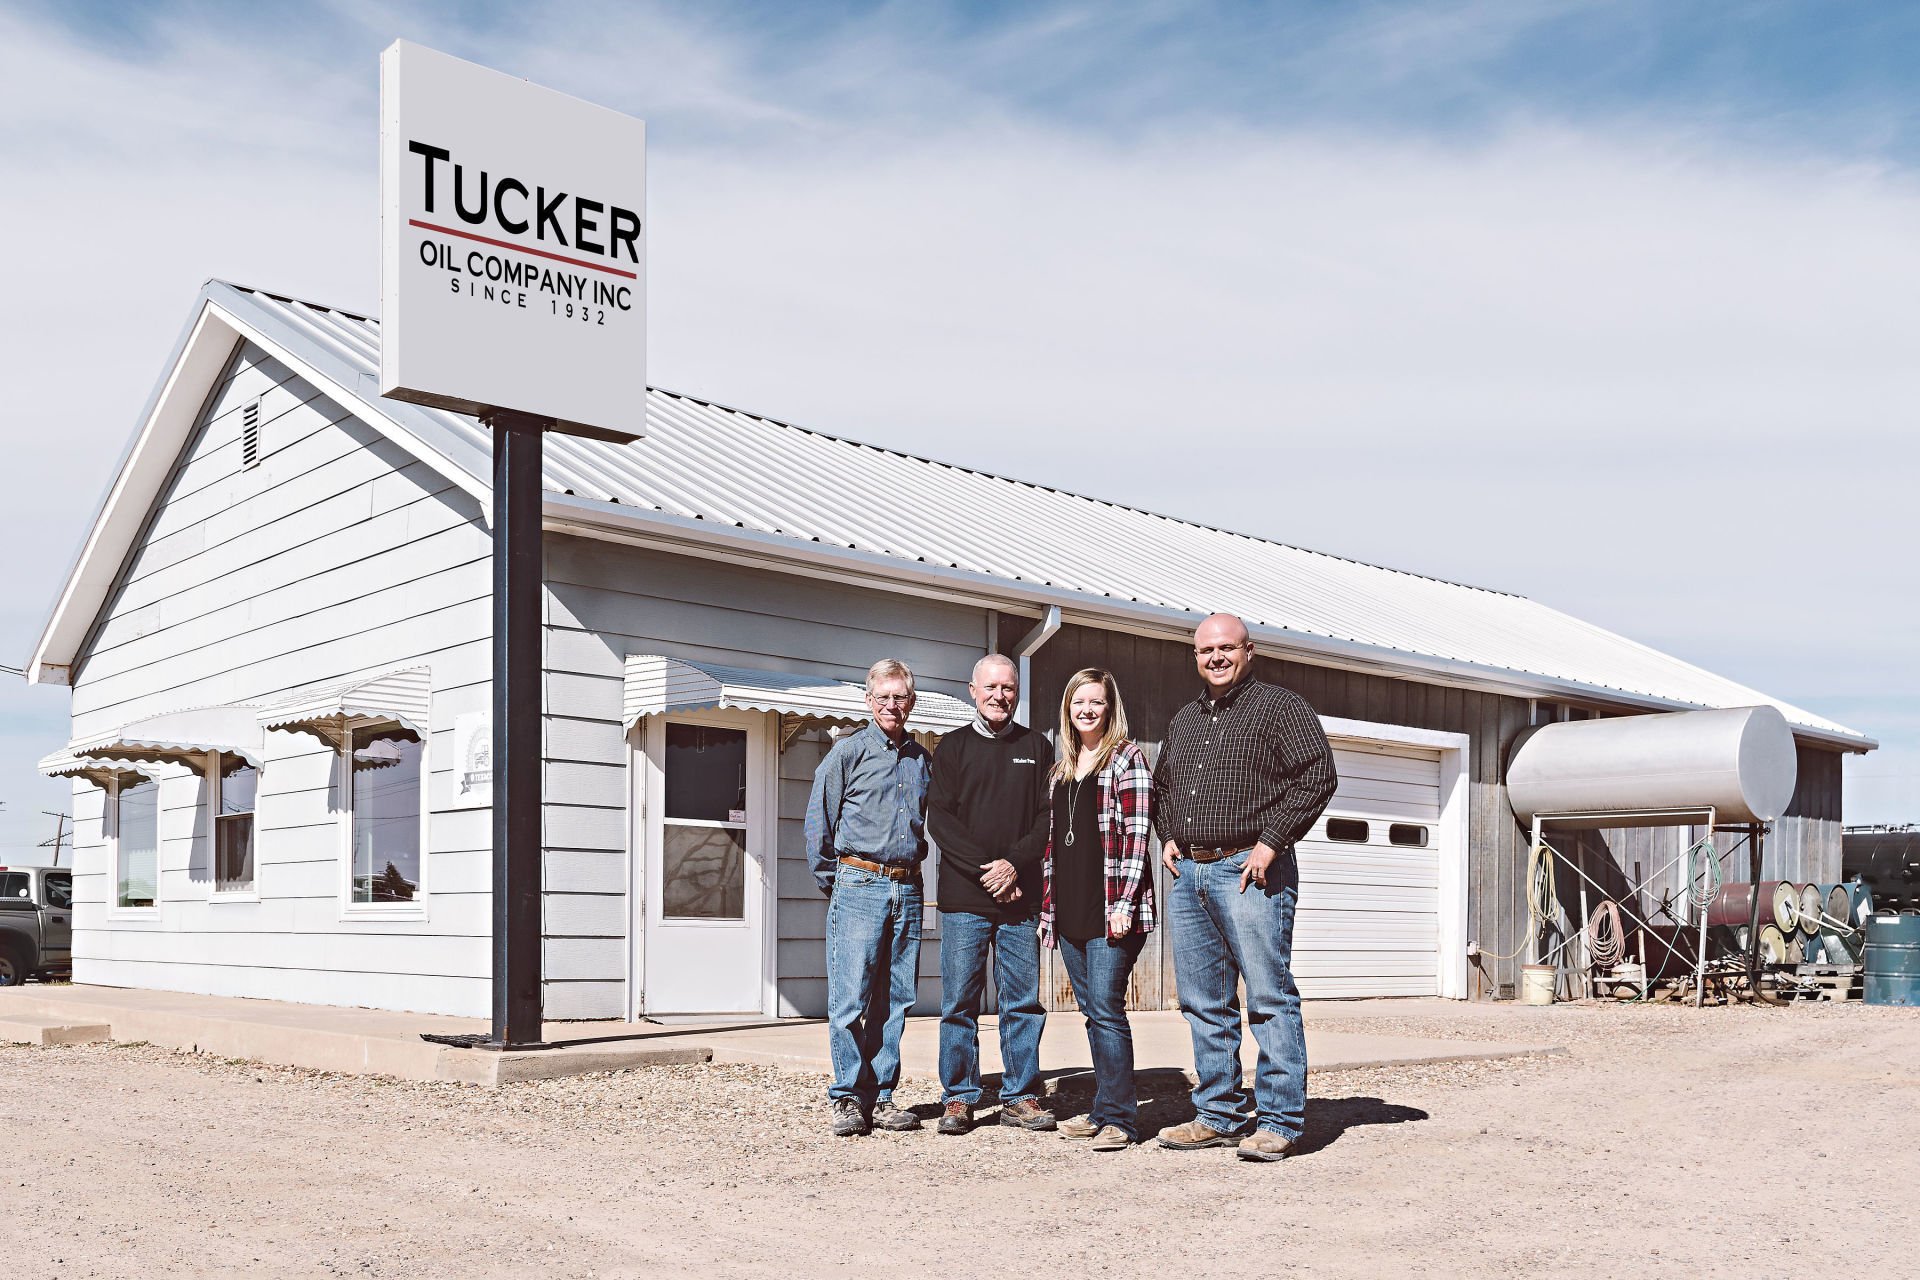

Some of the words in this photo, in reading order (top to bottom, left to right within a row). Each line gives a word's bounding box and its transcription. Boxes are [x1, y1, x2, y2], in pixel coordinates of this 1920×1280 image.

[408, 139, 642, 264] TUCKER
[419, 239, 462, 273] OIL
[466, 251, 588, 301] COMPANY
[593, 280, 632, 312] INC
[450, 277, 527, 309] SINCE
[551, 299, 605, 326] 1932
